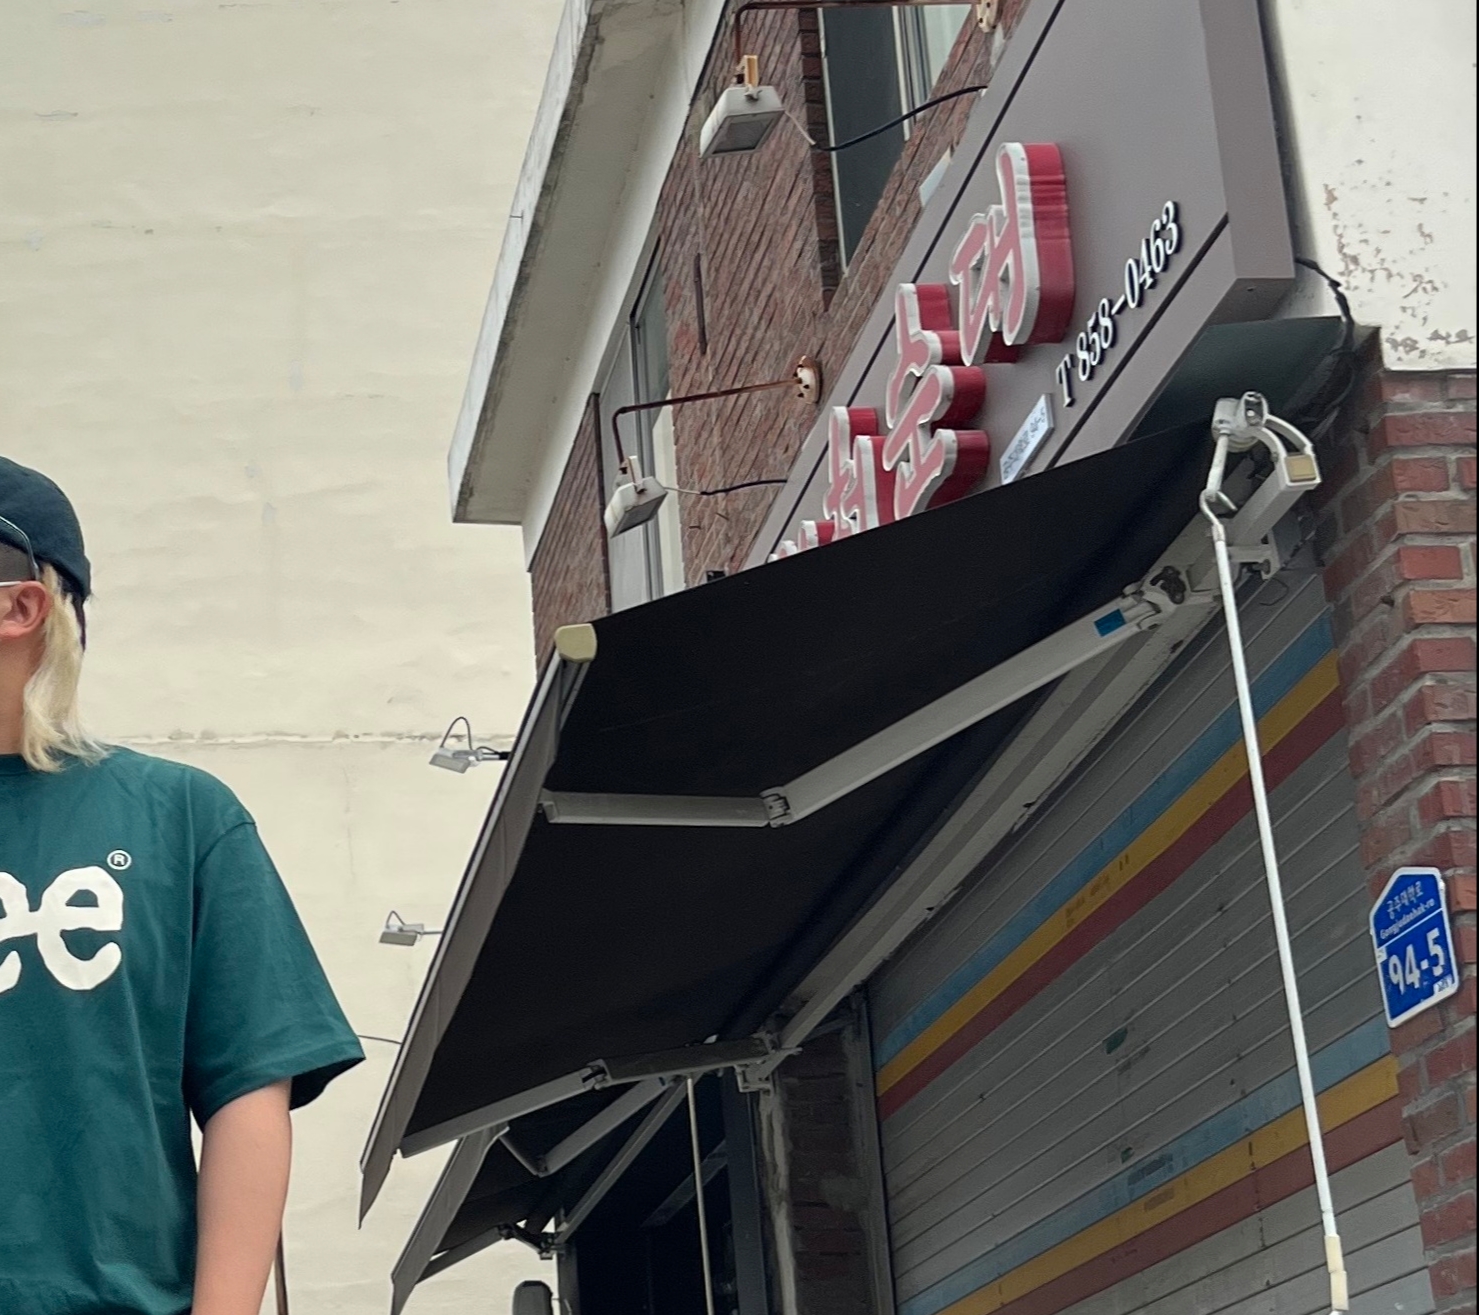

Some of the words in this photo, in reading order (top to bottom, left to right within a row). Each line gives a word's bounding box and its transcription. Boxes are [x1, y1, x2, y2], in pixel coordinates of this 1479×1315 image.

[1055, 353, 1072, 408] T
[1075, 200, 1179, 382] 858-0463
[1386, 880, 1424, 920] 공주대학로
[1388, 927, 1446, 996] 94-5
